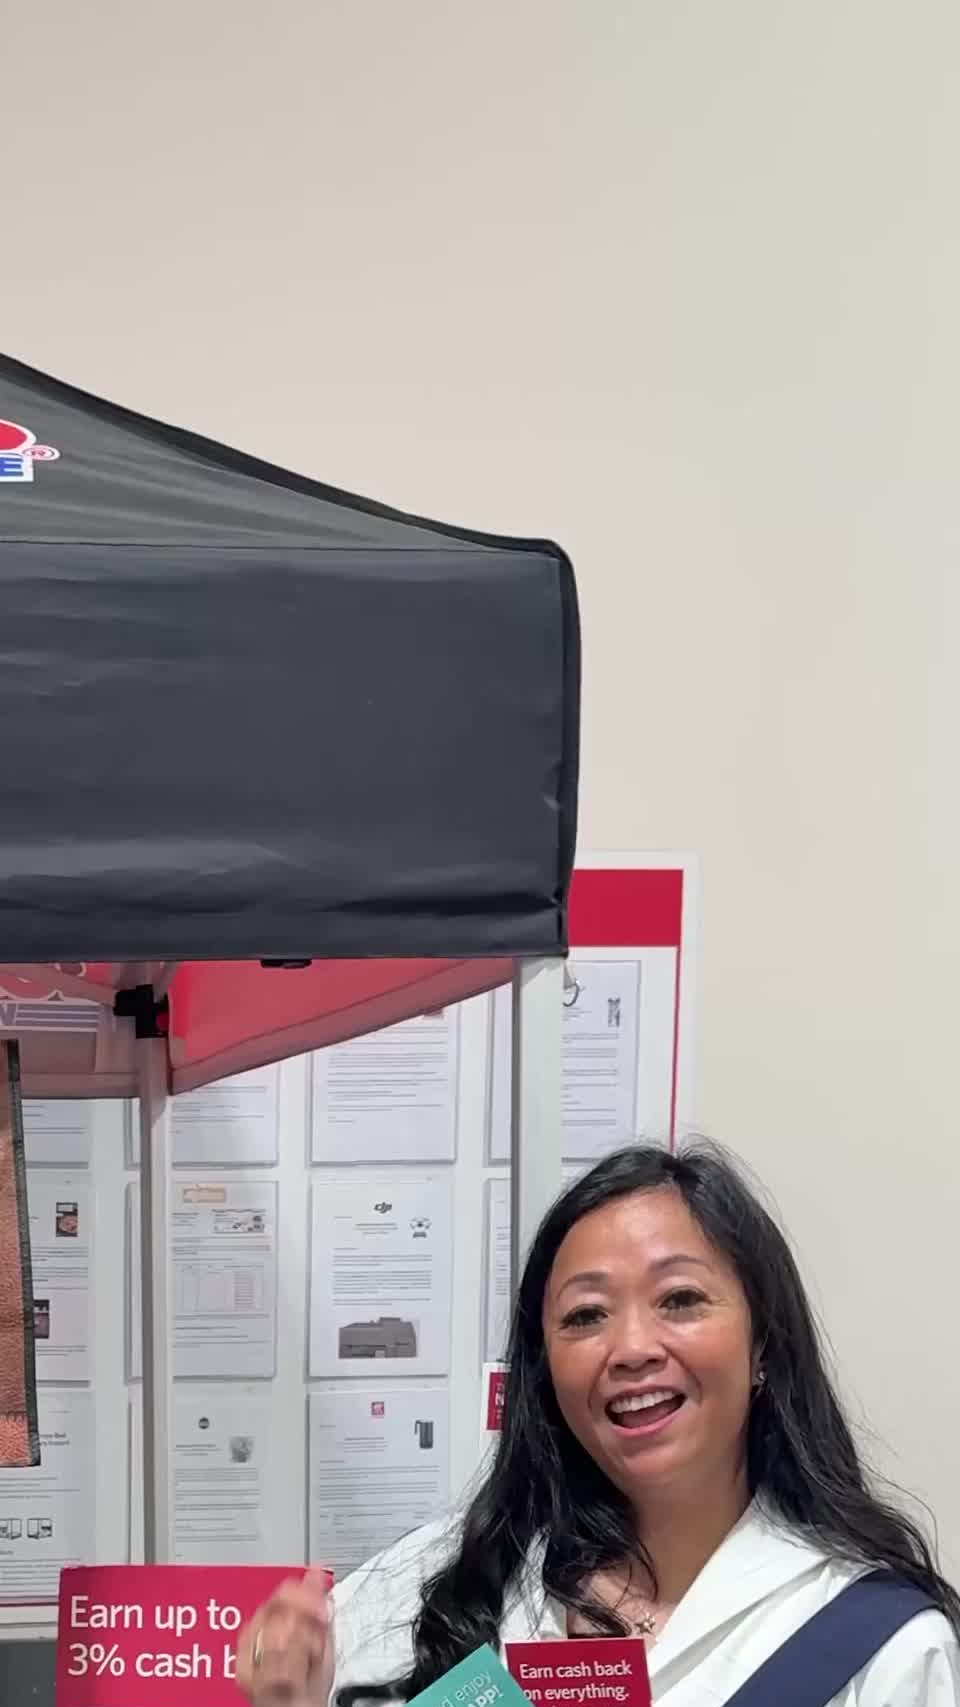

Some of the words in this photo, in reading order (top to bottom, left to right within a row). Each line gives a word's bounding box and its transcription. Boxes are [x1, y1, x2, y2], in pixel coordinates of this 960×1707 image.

[70, 1594, 143, 1628] Earn
[155, 1604, 198, 1637] up
[206, 1598, 241, 1631] to
[67, 1642, 126, 1677] 3%
[135, 1642, 212, 1679] cash
[519, 1663, 554, 1680] Earn
[555, 1660, 592, 1679] cash
[593, 1659, 633, 1677] back
[454, 1671, 492, 1701] enjoy
[523, 1688, 543, 1701] on
[544, 1682, 630, 1703] everything.
